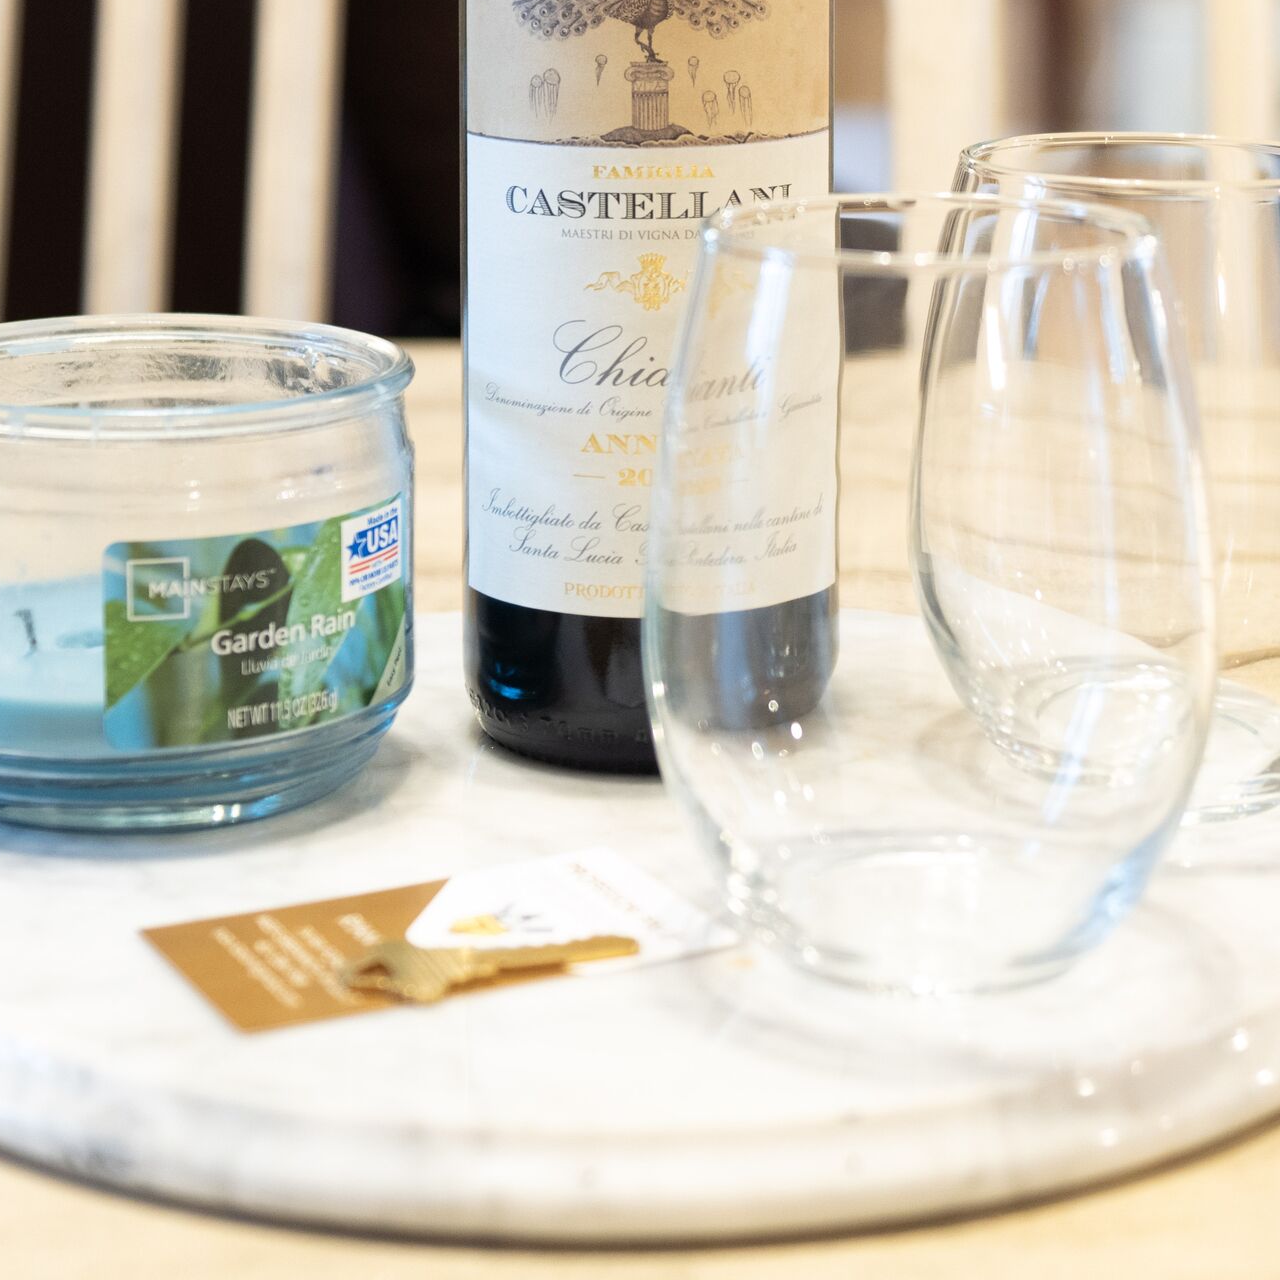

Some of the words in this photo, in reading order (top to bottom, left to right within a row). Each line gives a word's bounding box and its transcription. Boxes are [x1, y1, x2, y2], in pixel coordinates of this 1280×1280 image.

[592, 164, 716, 180] FAMIGLIA
[561, 228, 613, 240] MAESTRI
[619, 230, 633, 240] DI
[637, 230, 680, 241] VIGNA
[485, 382, 573, 416] Denominazione
[576, 401, 591, 416] di
[599, 396, 653, 422] Origine
[481, 487, 575, 531] Imbottigliato
[578, 511, 602, 531] da
[366, 519, 398, 554] USA
[509, 526, 560, 560] Santa
[564, 535, 624, 565] Lucia
[210, 622, 306, 657] Garden
[310, 607, 356, 638] Rain
[227, 705, 251, 729] NET
[249, 702, 269, 726] WT
